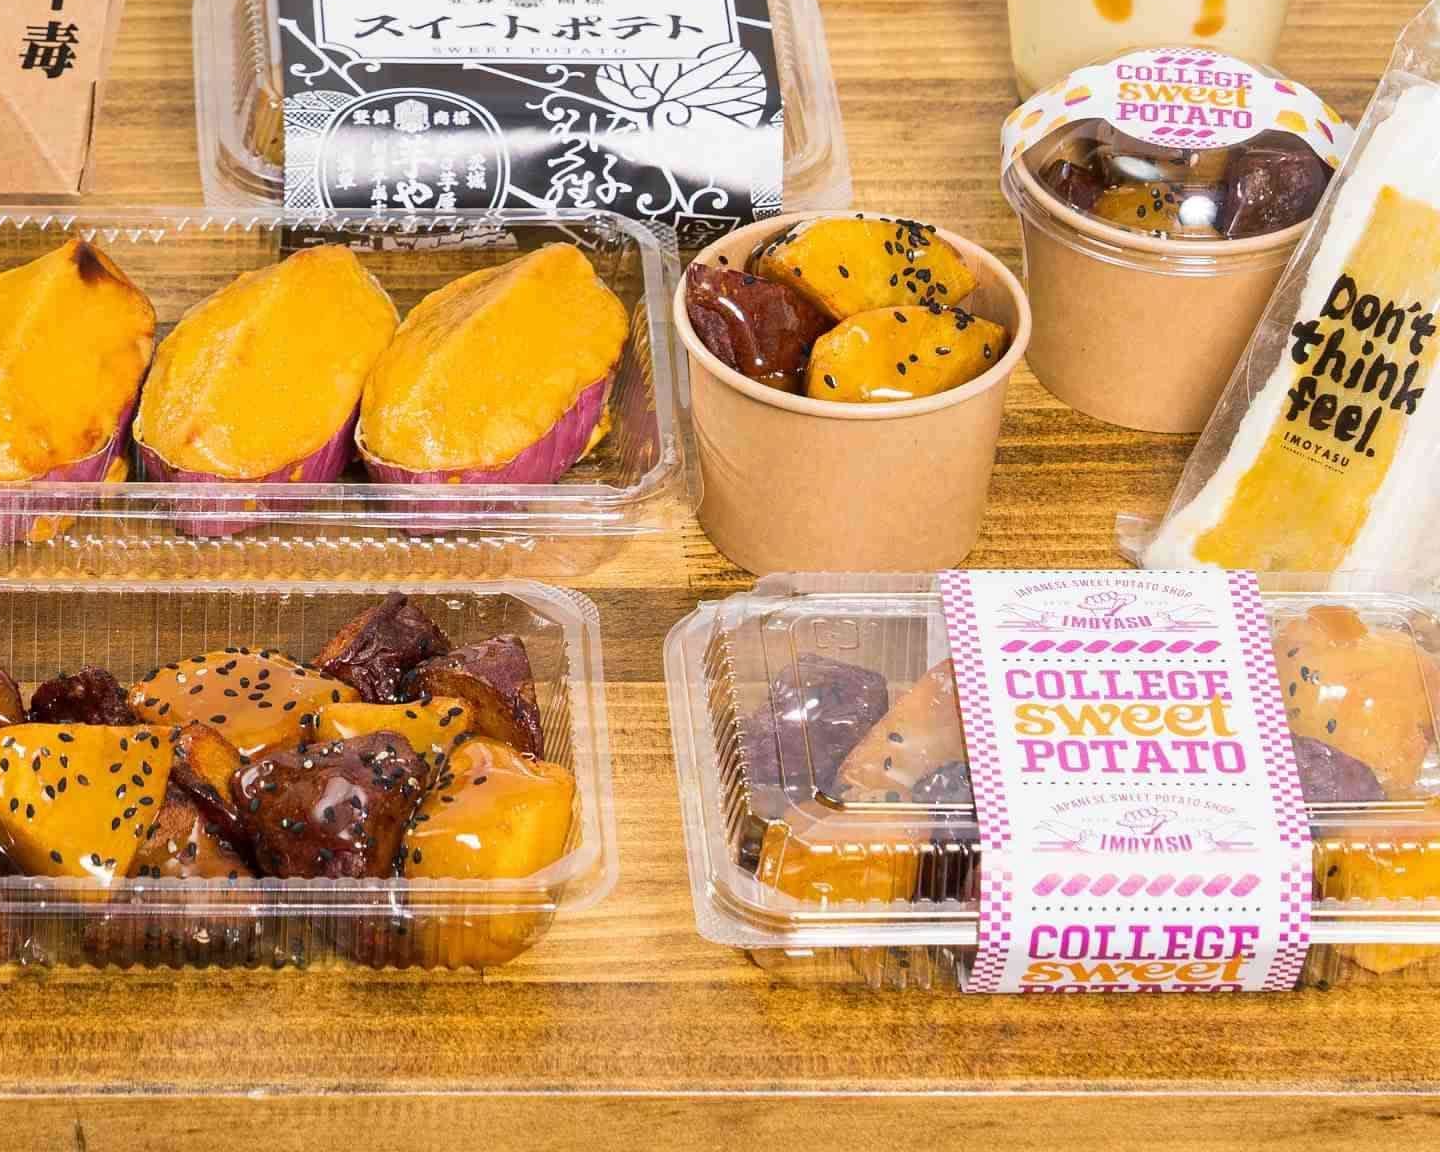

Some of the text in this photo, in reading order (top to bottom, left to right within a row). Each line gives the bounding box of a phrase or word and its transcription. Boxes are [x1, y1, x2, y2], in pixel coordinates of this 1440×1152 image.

[354, 13, 705, 41] スイートポテト
[1116, 64, 1253, 89] COLLEGE
[1117, 81, 1253, 109] sweet
[1116, 102, 1253, 129] POTATO
[1320, 273, 1436, 356] Don't
[1291, 320, 1425, 416] think
[1286, 376, 1383, 458] feel.
[1283, 431, 1351, 467] IMOYASU
[1115, 579, 1159, 592] POTATO
[1162, 584, 1194, 599] SHOP
[1062, 615, 1153, 630] IMOYASU
[1005, 669, 1232, 701] COLLEGE
[1014, 693, 1238, 737] sweet
[1016, 739, 1246, 774] POTATO
[1099, 833, 1193, 853] IMOYASU
[1028, 925, 1260, 960] COLLEGE
[1021, 952, 1248, 983] sweet
